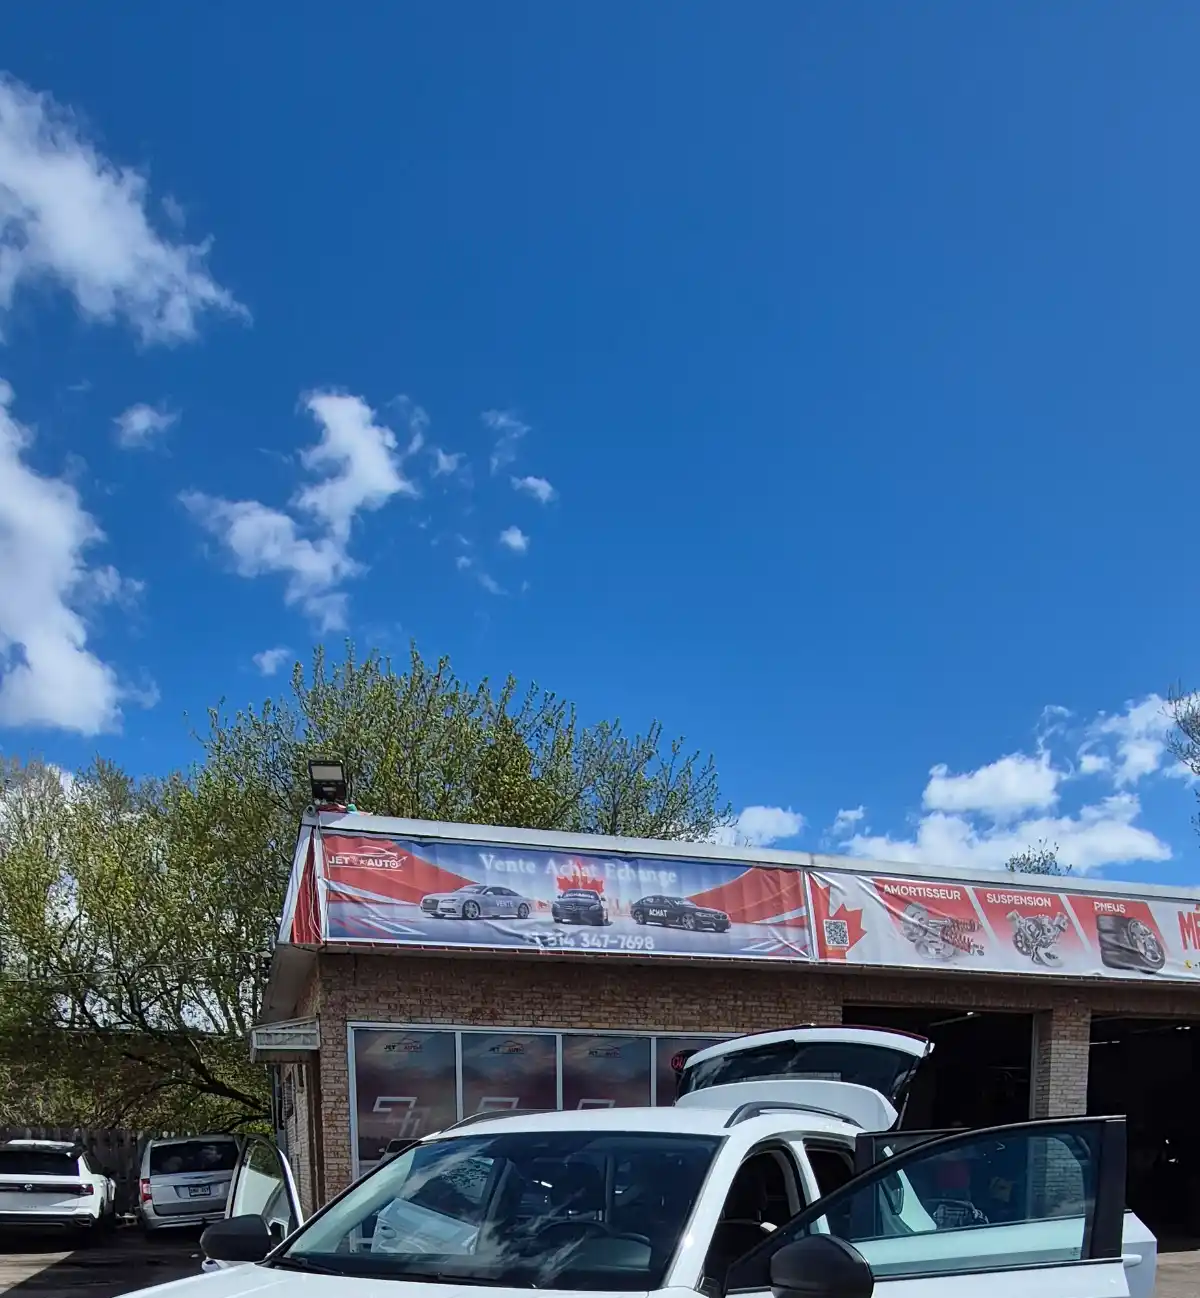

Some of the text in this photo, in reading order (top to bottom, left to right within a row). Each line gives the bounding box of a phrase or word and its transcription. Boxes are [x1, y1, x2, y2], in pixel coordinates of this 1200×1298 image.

[329, 855, 399, 869] JET AUTO
[479, 853, 677, 889] Vente Achat Echange
[883, 884, 961, 901] AMORTISSEUR
[986, 893, 1052, 908] SUSPENSION
[1093, 901, 1126, 914] PNEUS
[648, 908, 668, 918] ACHAT
[580, 934, 655, 950] 347-7698
